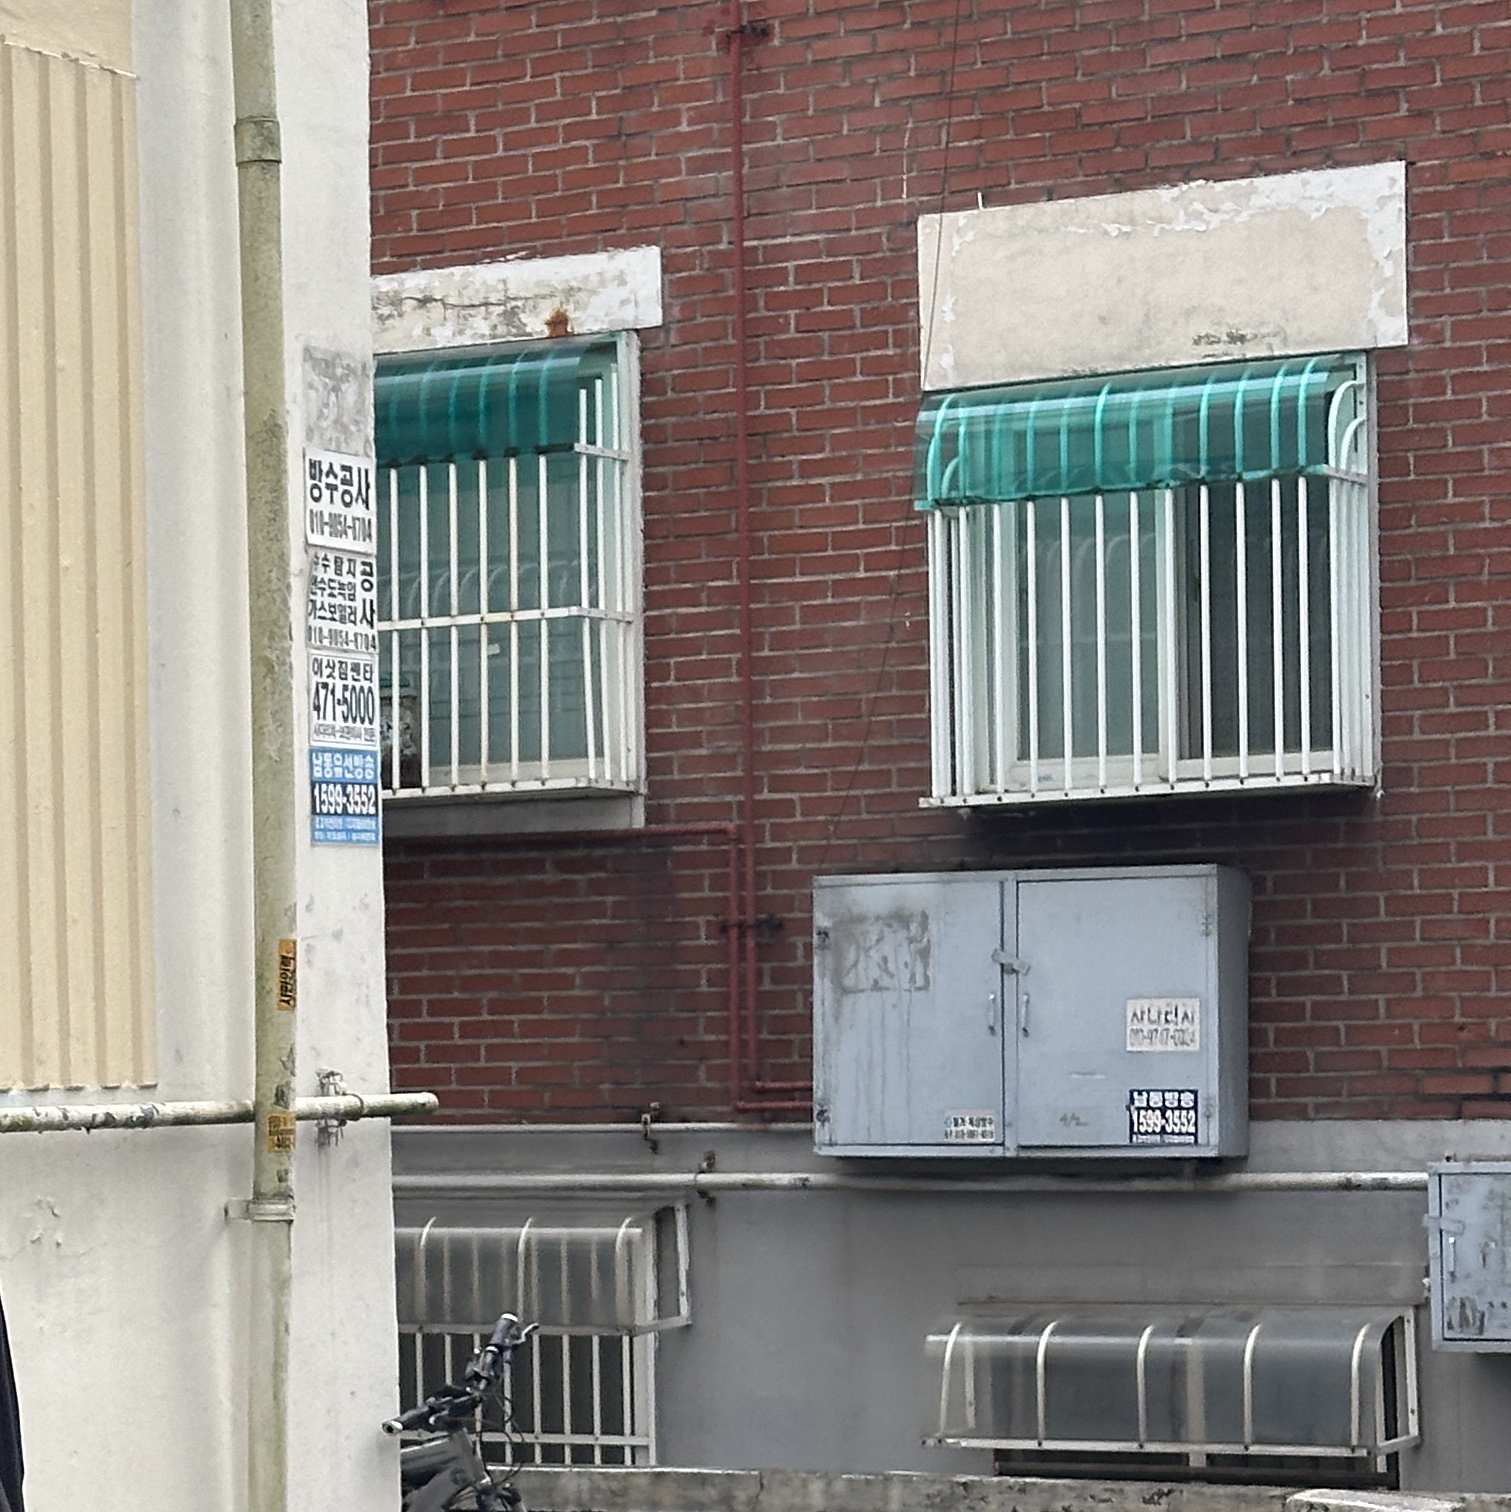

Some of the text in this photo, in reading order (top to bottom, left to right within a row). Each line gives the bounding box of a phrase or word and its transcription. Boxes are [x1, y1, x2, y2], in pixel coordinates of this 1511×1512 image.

[308, 457, 372, 511] 방수공사
[307, 598, 357, 626] 가스보일러
[312, 681, 376, 726] 471-5000
[313, 783, 377, 815] 1599-3552
[1133, 1108, 1196, 1134] 1599-3552
